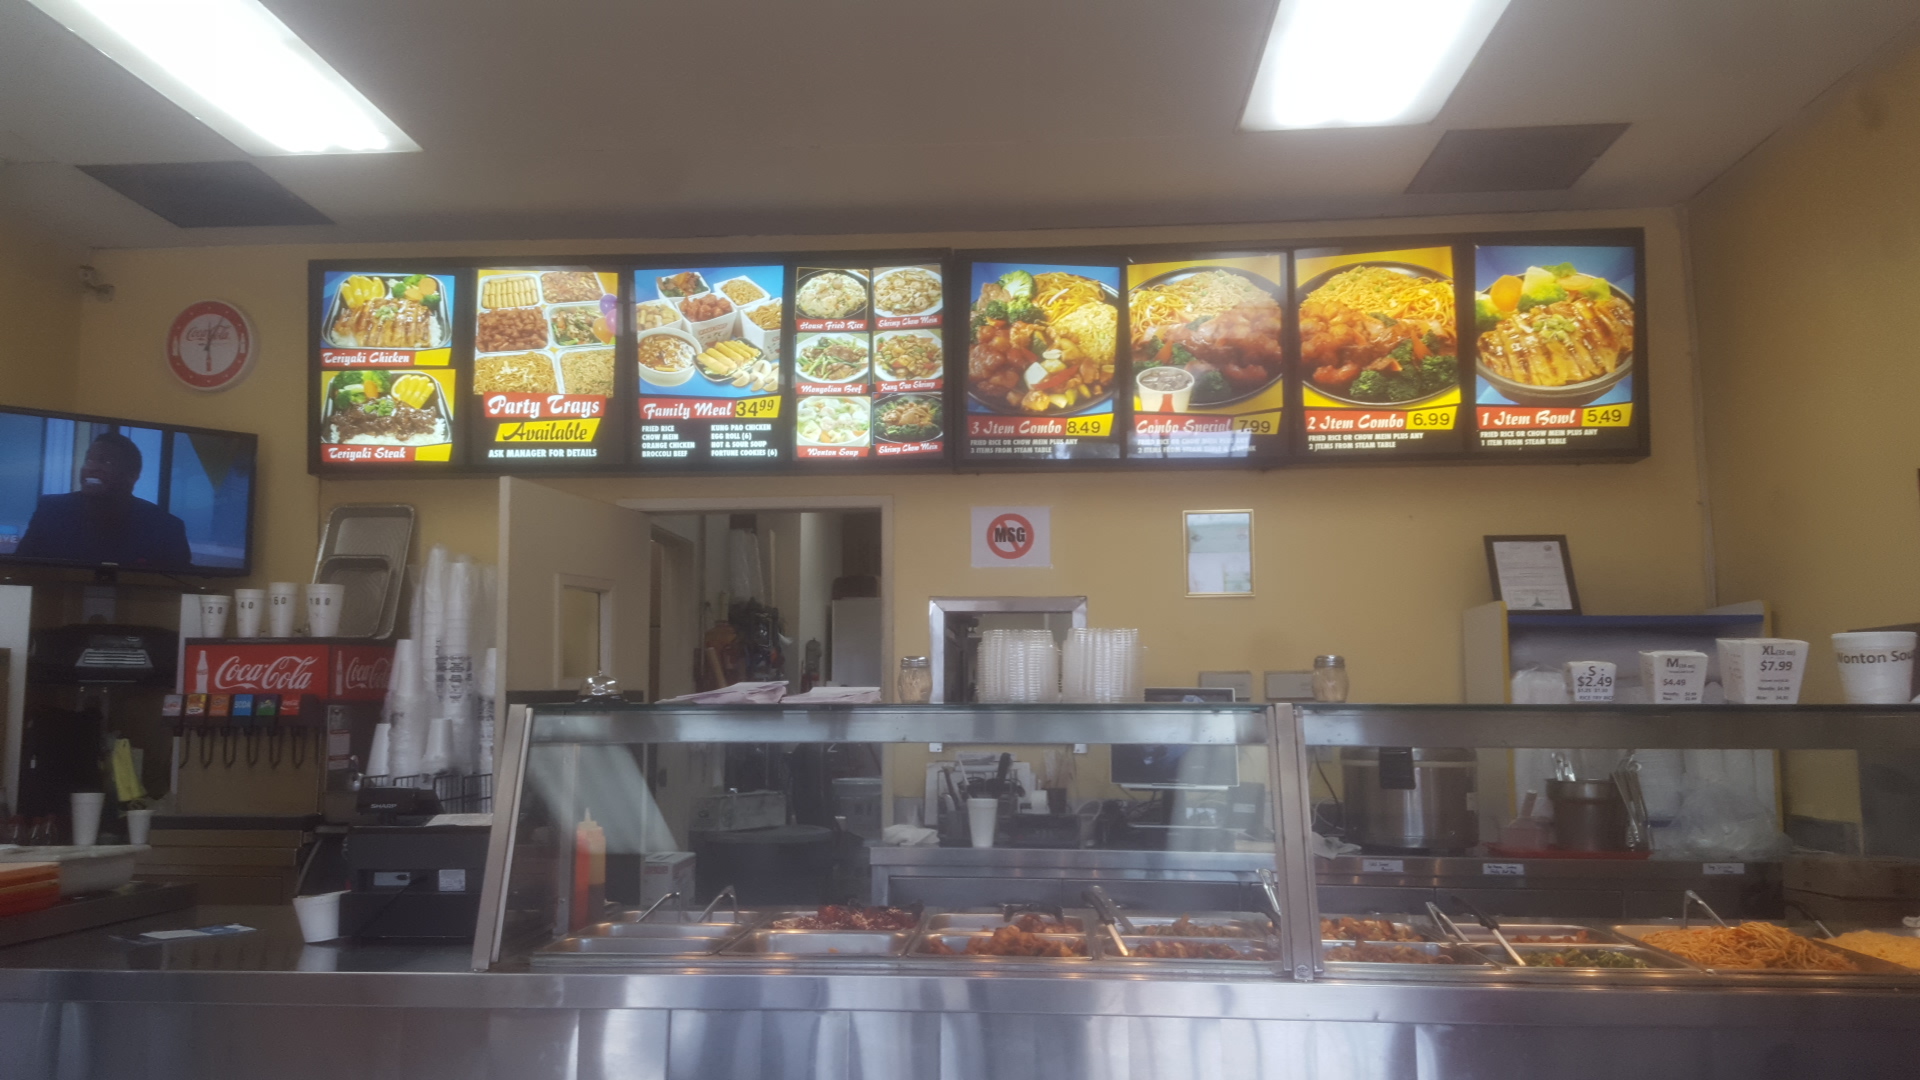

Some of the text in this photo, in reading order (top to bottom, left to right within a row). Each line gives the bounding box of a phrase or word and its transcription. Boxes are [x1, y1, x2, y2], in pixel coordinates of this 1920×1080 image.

[825, 321, 845, 331] Fried
[847, 320, 864, 330] Rice
[323, 351, 410, 366] Teriyaki Chicken
[801, 384, 863, 394] Mongolian Beef
[488, 395, 600, 418] Party Trays
[643, 401, 732, 419] Family Meal
[1307, 413, 1404, 429] 2 Item Combo
[1413, 412, 1450, 426] 6.99
[1482, 409, 1576, 425] 1 Item Bowl
[1587, 409, 1622, 424] 5.49
[503, 421, 587, 441] Available
[745, 423, 772, 431] CHICKEN
[971, 419, 1062, 434] 3 Item Combo
[1066, 420, 1101, 434] 8.49
[1136, 418, 1231, 435] Combo Special
[1239, 419, 1271, 433] 7.99
[641, 433, 679, 441] CHOW MEIN
[725, 432, 741, 440] ROLL
[669, 441, 696, 449] CHICKEN
[750, 440, 767, 448] SOUP
[328, 447, 406, 461] Teriyaki Steak
[488, 448, 597, 458] ASK MANAGER FOR DETAILS
[710, 449, 739, 457] FORTUNE
[838, 447, 859, 457] Soup
[994, 527, 1026, 543] MSG
[214, 655, 319, 690] Coca-Cola
[1760, 660, 1793, 672] $7.99
[1577, 677, 1612, 687] $2.49
[1663, 678, 1686, 686] $4.49
